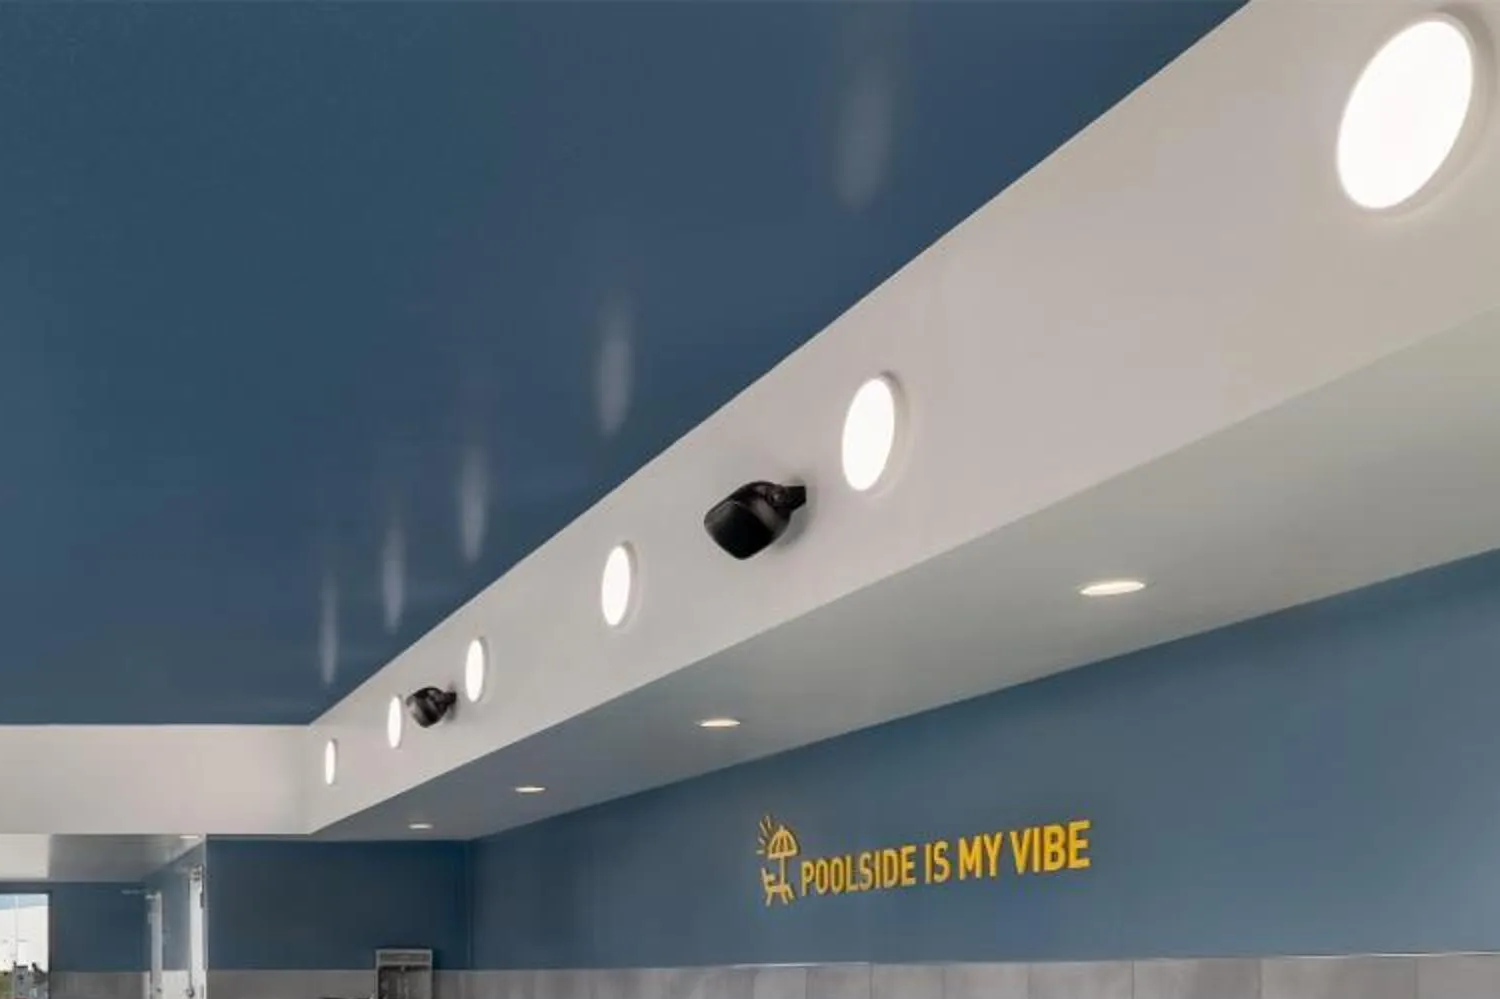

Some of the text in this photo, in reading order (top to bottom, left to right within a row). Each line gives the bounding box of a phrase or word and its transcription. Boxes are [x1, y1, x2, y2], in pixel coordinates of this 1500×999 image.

[800, 819, 1092, 897] POOLSIDE IS MY VIBE
